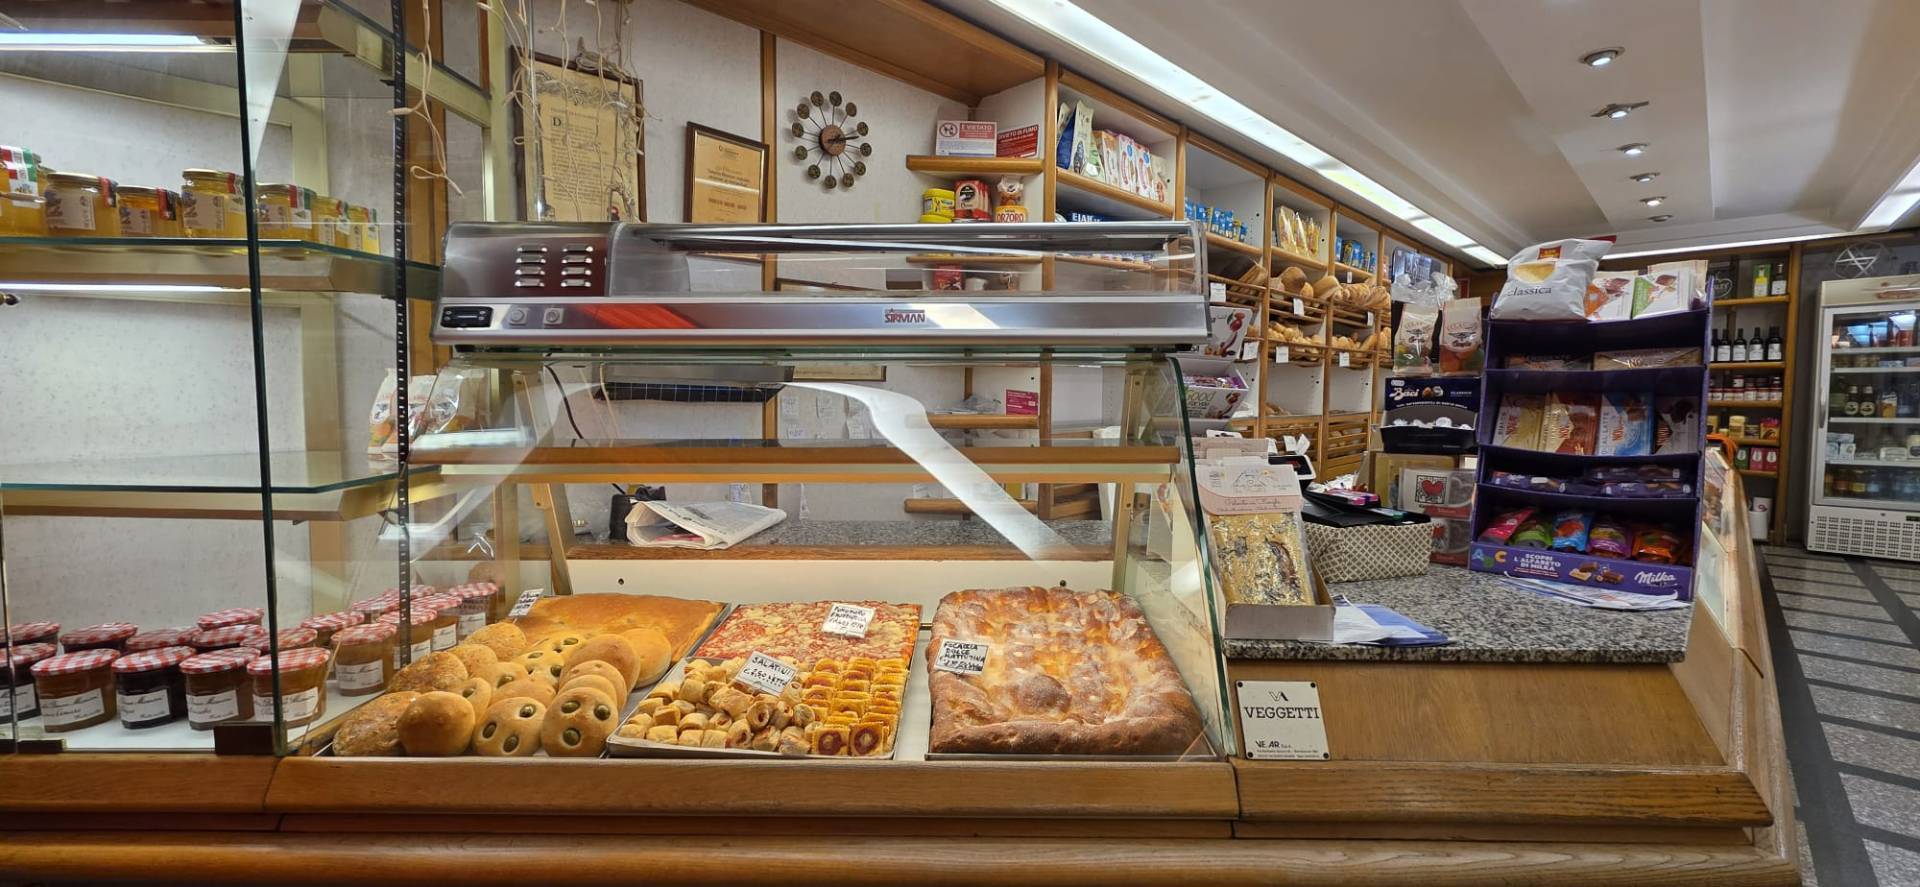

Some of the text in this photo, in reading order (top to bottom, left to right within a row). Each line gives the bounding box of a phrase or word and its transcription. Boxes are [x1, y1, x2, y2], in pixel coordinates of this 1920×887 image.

[884, 312, 926, 323] SIRMAN
[1525, 553, 1553, 561] SCOPRI
[1530, 563, 1556, 571] MILKA
[1633, 571, 1677, 585] Milka
[1243, 706, 1320, 720] VEGGETTI
